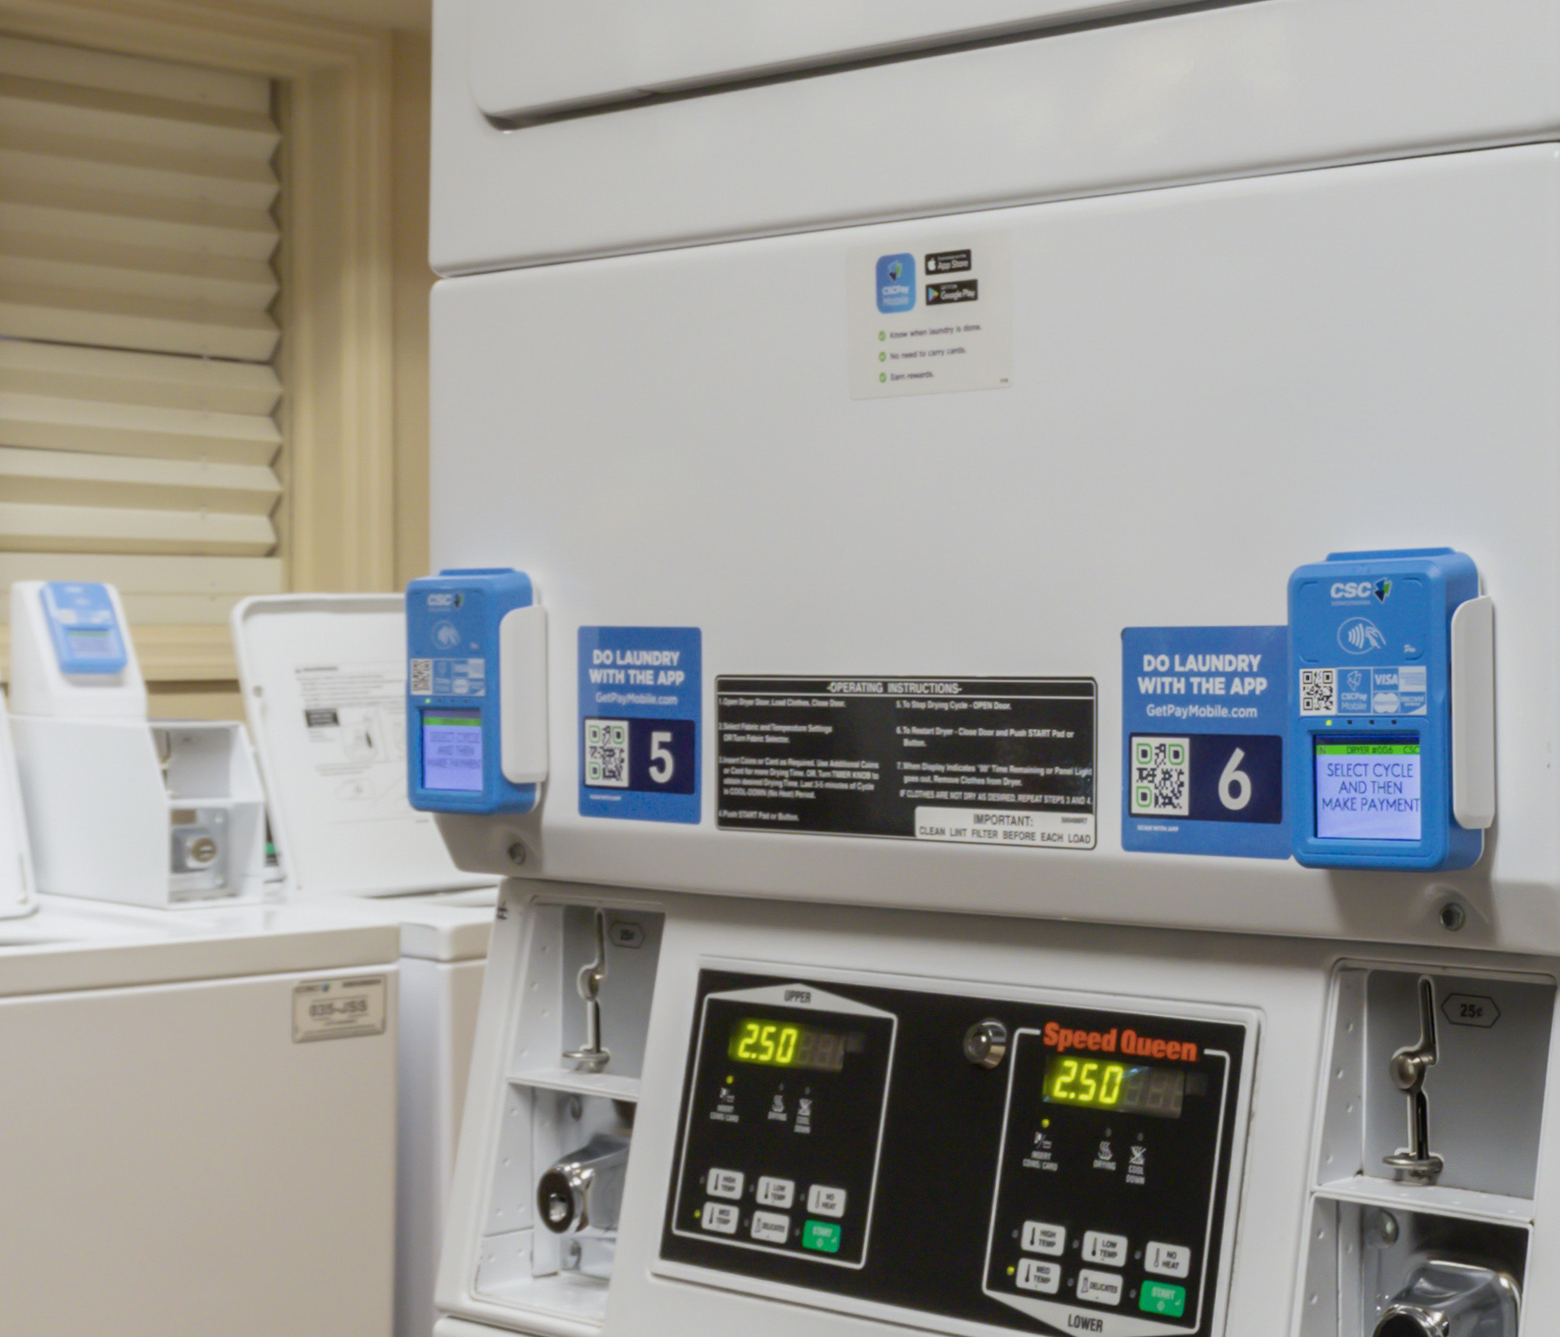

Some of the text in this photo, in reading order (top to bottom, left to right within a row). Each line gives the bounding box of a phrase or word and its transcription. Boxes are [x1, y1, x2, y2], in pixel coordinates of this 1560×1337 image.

[1330, 581, 1372, 599] CSC
[593, 650, 680, 666] DO LAUNDRY
[1143, 654, 1262, 673] DO LAUNDRY
[589, 668, 685, 686] WITH THE APP
[1137, 677, 1268, 696] WITH THE APP
[1375, 674, 1398, 686] VISA
[596, 692, 678, 706] GetPayMobile.com
[1146, 704, 1258, 720] GetPayMobile.com
[648, 731, 675, 784] 5
[1218, 747, 1252, 811] 6
[784, 990, 811, 1004] UPPER
[738, 1023, 798, 1064] 2.50
[1043, 1021, 1198, 1062] Speed Queen
[1053, 1059, 1123, 1104] 2.50
[1067, 1314, 1104, 1333] LOWER
